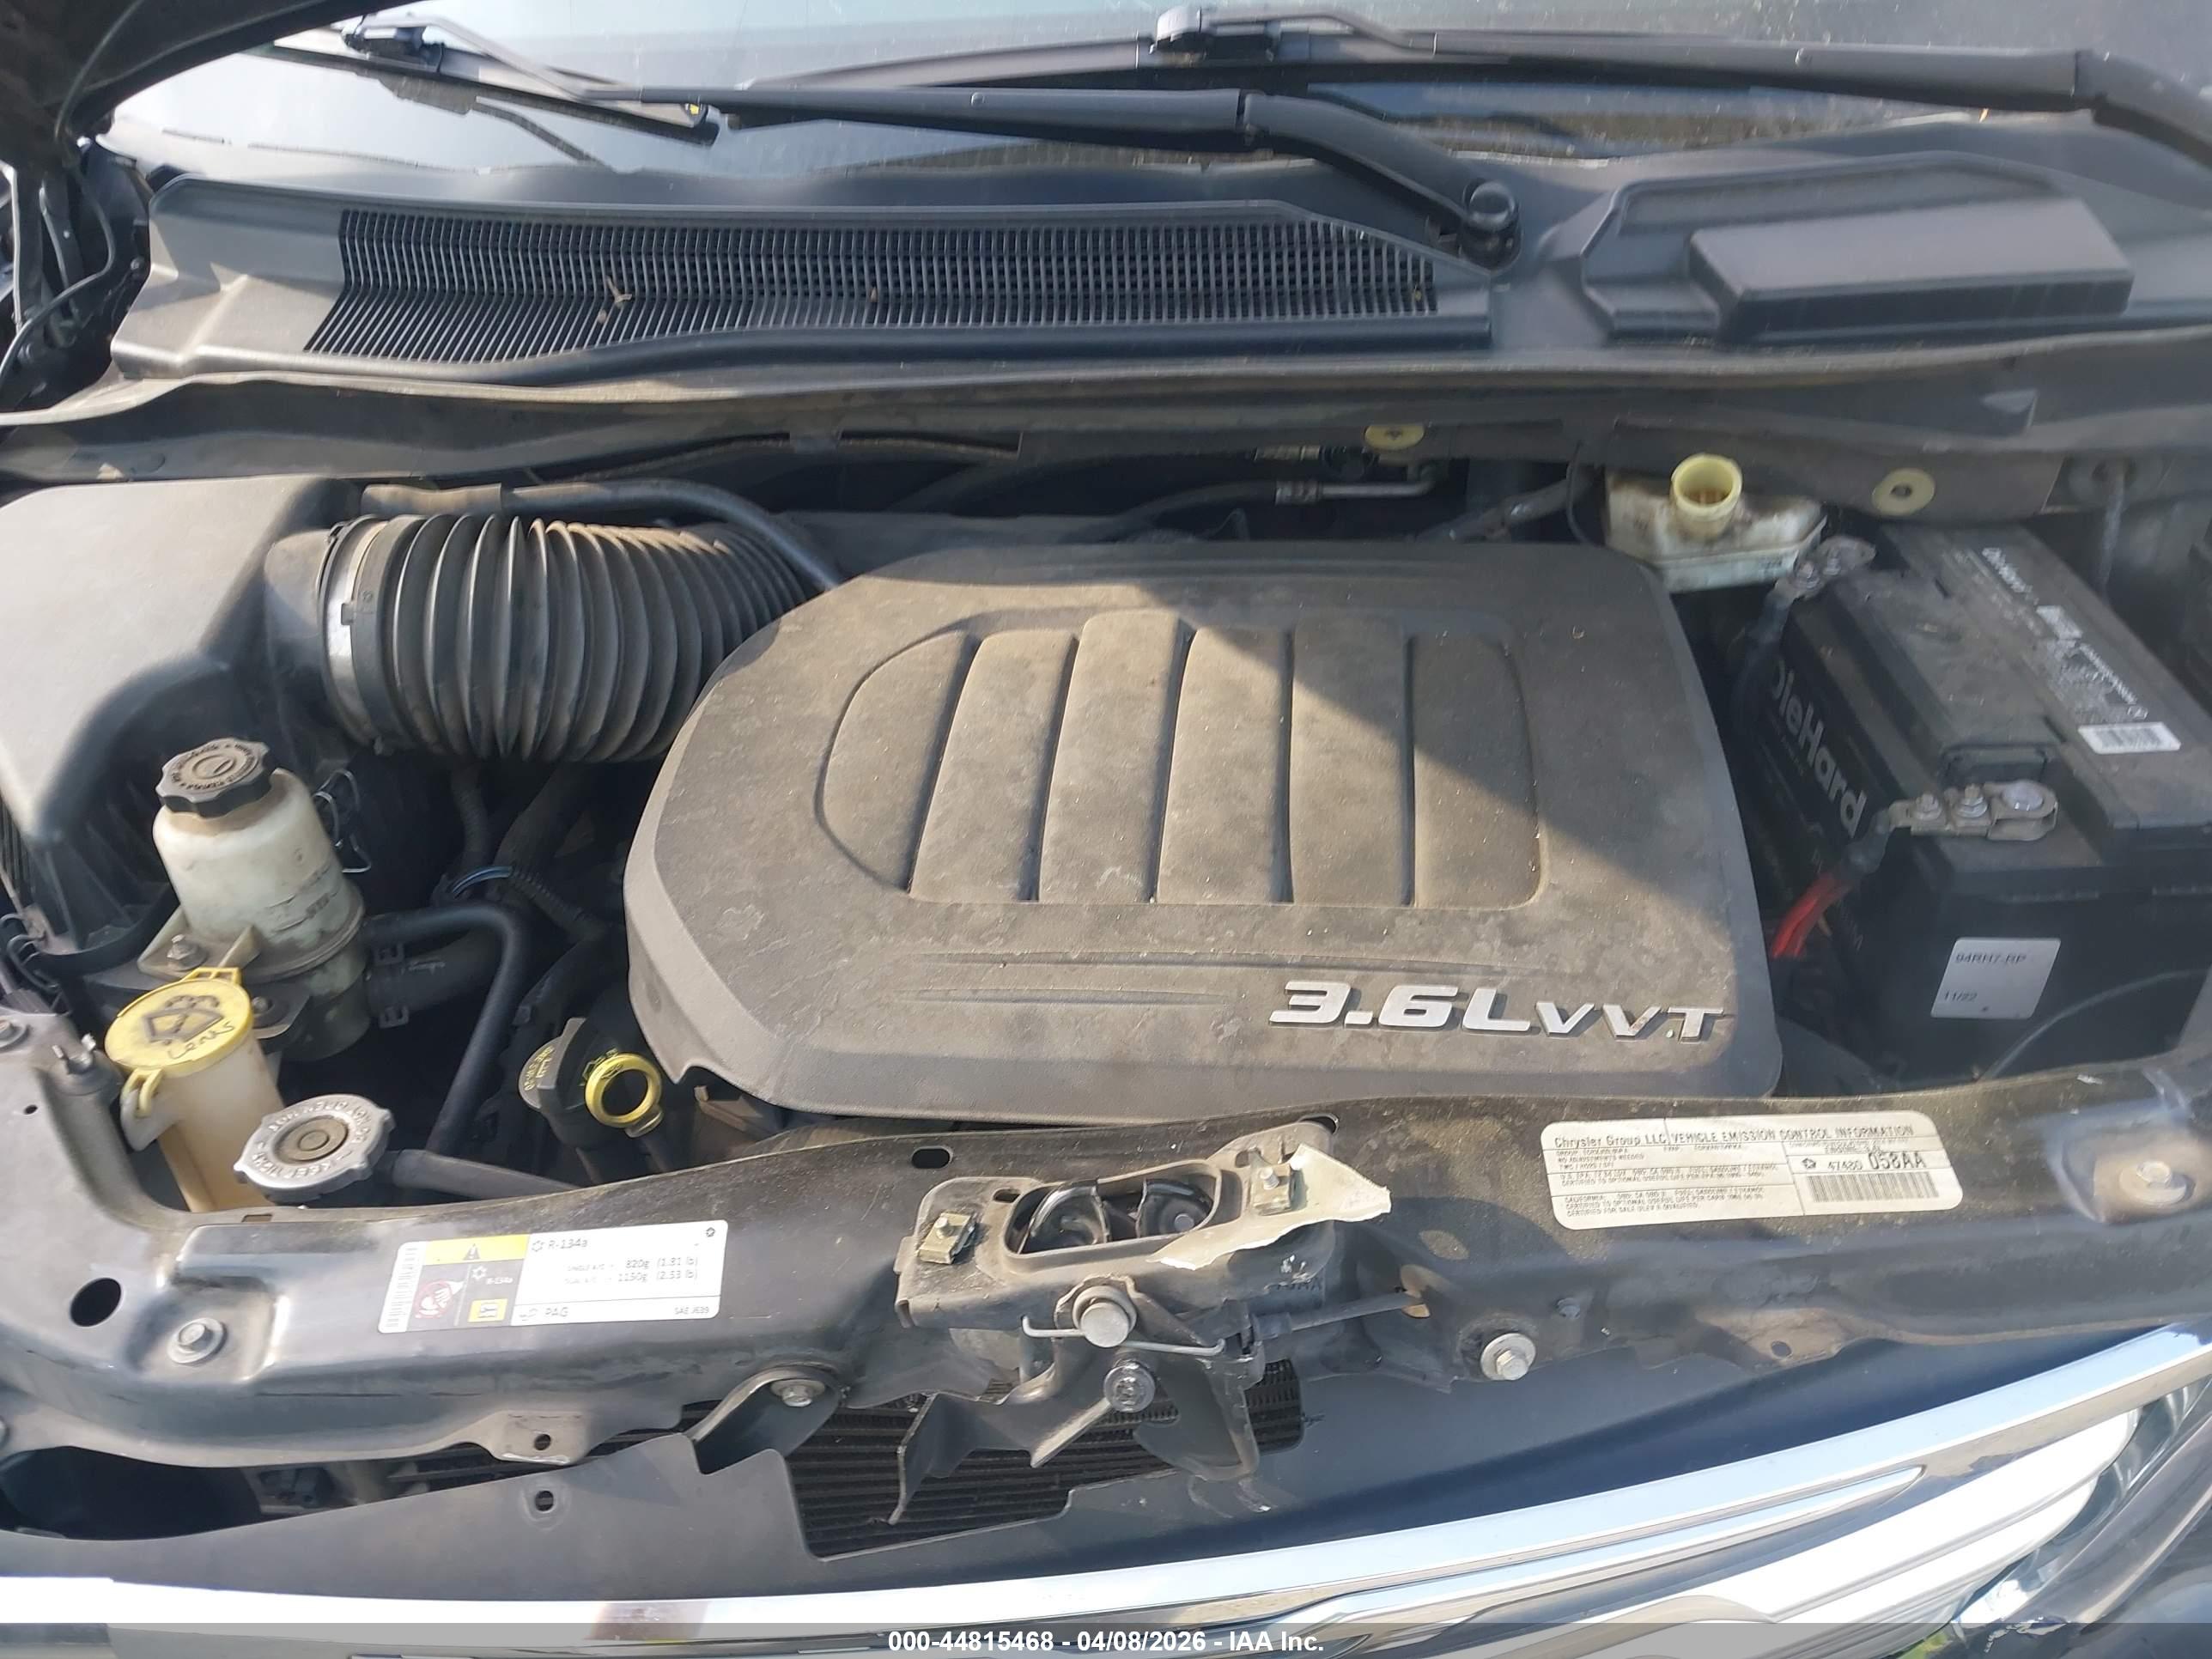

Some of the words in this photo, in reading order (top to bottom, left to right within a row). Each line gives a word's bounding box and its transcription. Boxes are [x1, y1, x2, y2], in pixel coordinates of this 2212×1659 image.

[1269, 981, 1532, 1031] 3.6L
[1536, 1001, 1724, 1041] VVT
[1554, 1136, 1601, 1149] Chrysler
[1606, 1134, 1642, 1147] Group
[1644, 1133, 1666, 1145] LLC
[1671, 1131, 1718, 1144] VEHICLE
[1722, 1128, 1776, 1142] EMISSION
[1779, 1127, 1832, 1140] CONTROL
[1834, 1124, 1915, 1138] INFORMATION
[549, 1238, 588, 1249] R-134a
